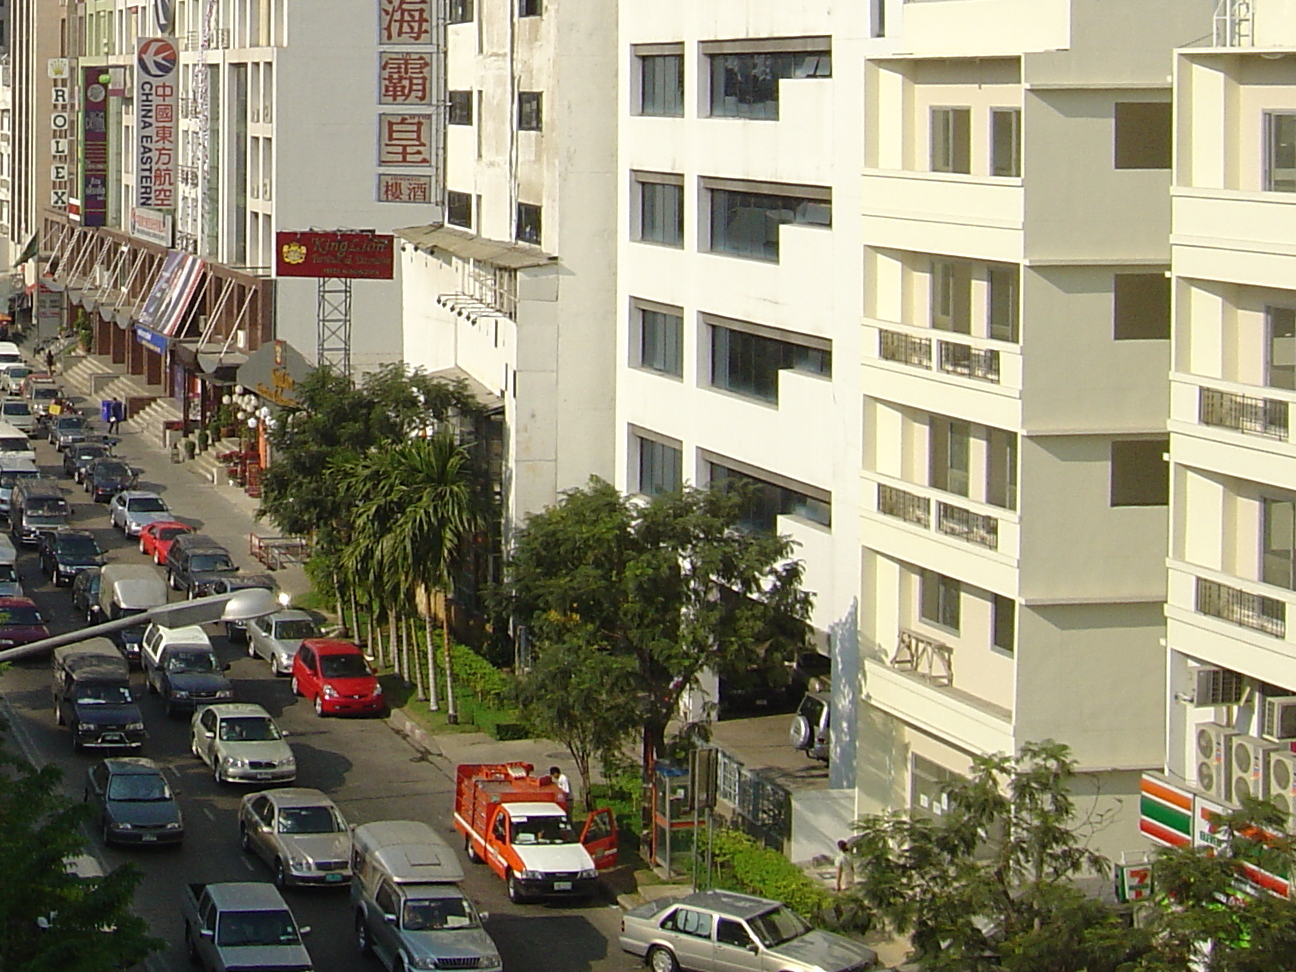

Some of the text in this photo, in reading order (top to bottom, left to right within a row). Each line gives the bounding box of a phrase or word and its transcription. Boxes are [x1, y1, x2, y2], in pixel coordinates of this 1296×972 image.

[52, 89, 68, 206] ROLEX
[141, 81, 154, 130] CHINA
[153, 82, 175, 207] 中國東方航空
[139, 135, 153, 207] EASTERN
